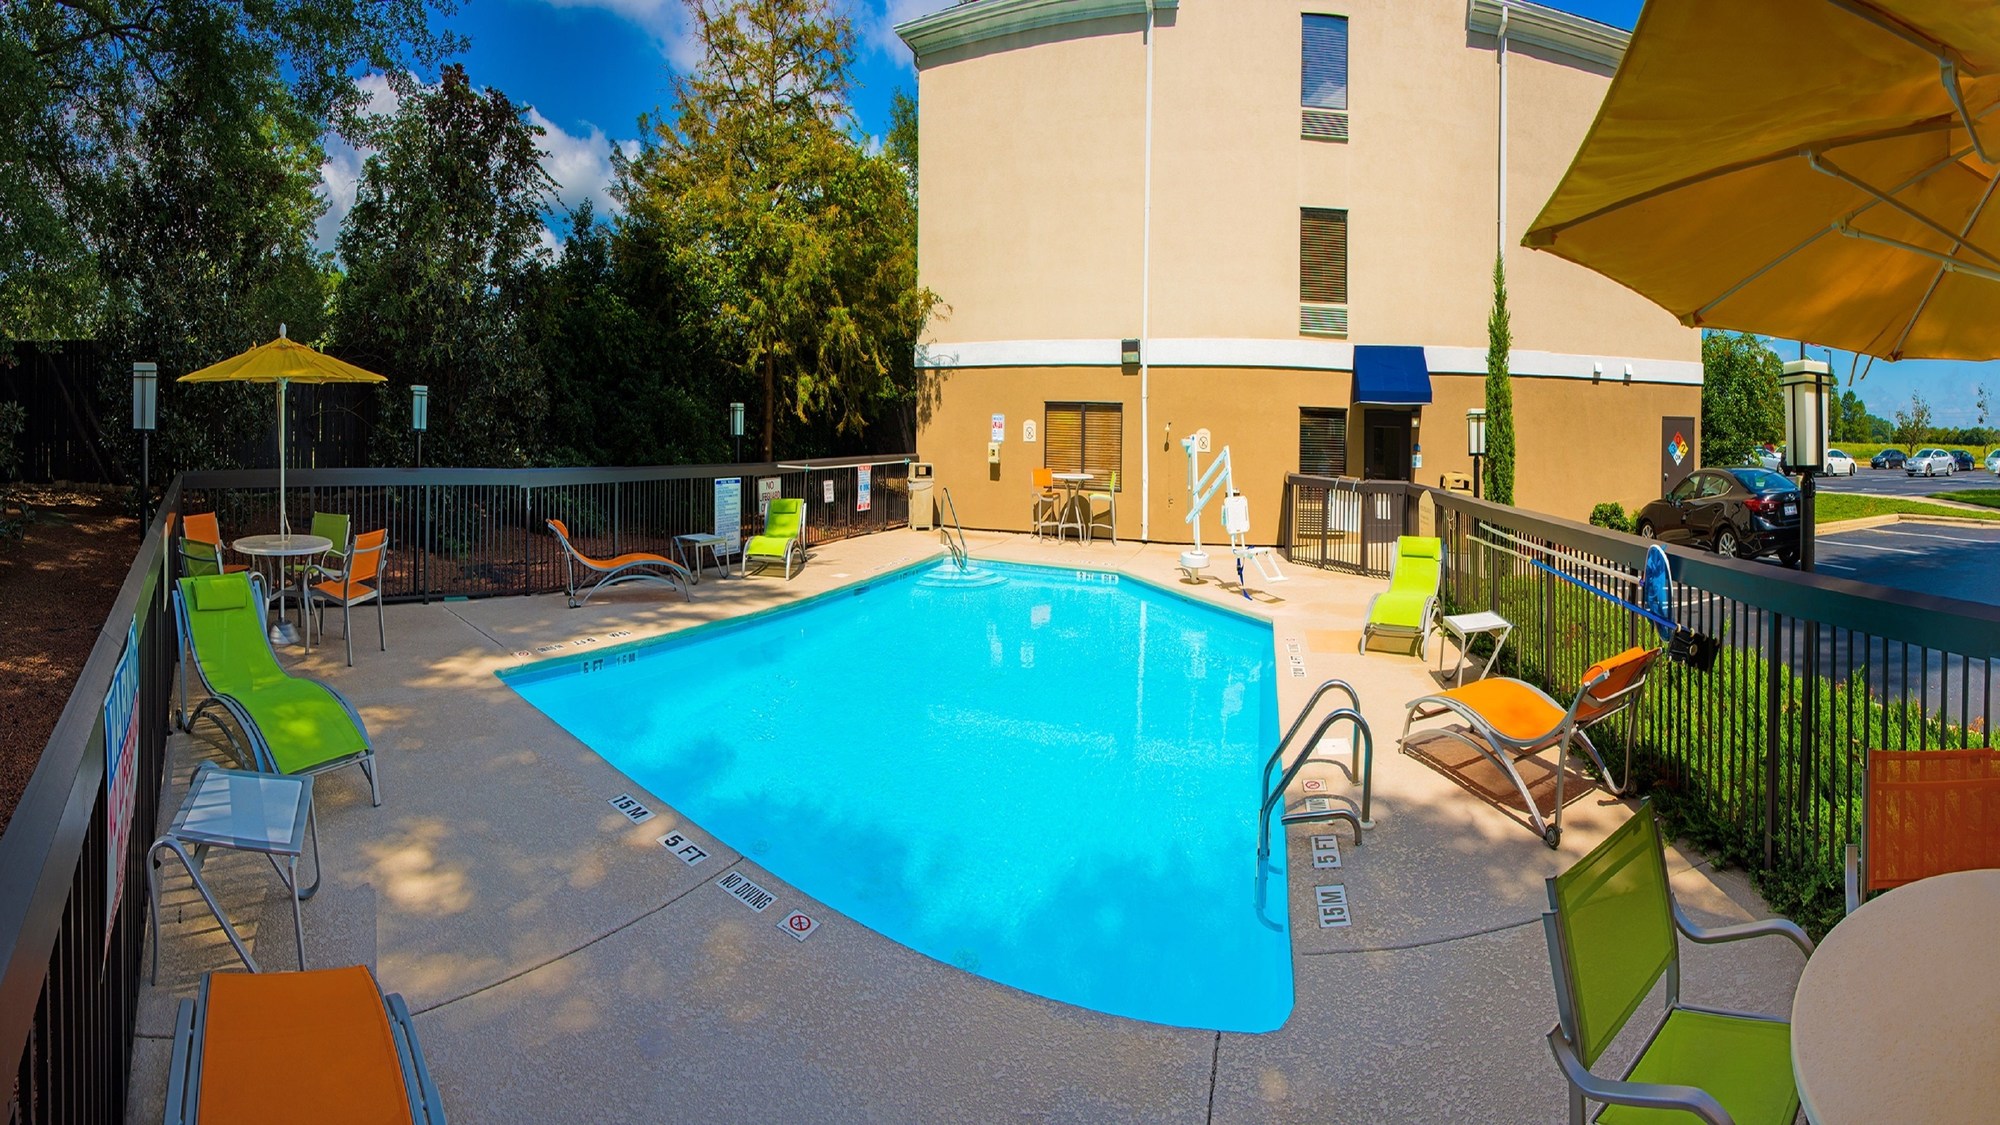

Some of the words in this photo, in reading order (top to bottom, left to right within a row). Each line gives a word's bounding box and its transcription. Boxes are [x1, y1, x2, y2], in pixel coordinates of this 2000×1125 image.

[765, 481, 775, 490] NO
[664, 834, 684, 848] 5
[678, 844, 707, 863] FT
[1314, 837, 1335, 851] FT
[1317, 854, 1337, 864] 5
[719, 872, 742, 889] NO
[734, 881, 773, 910] DIVING
